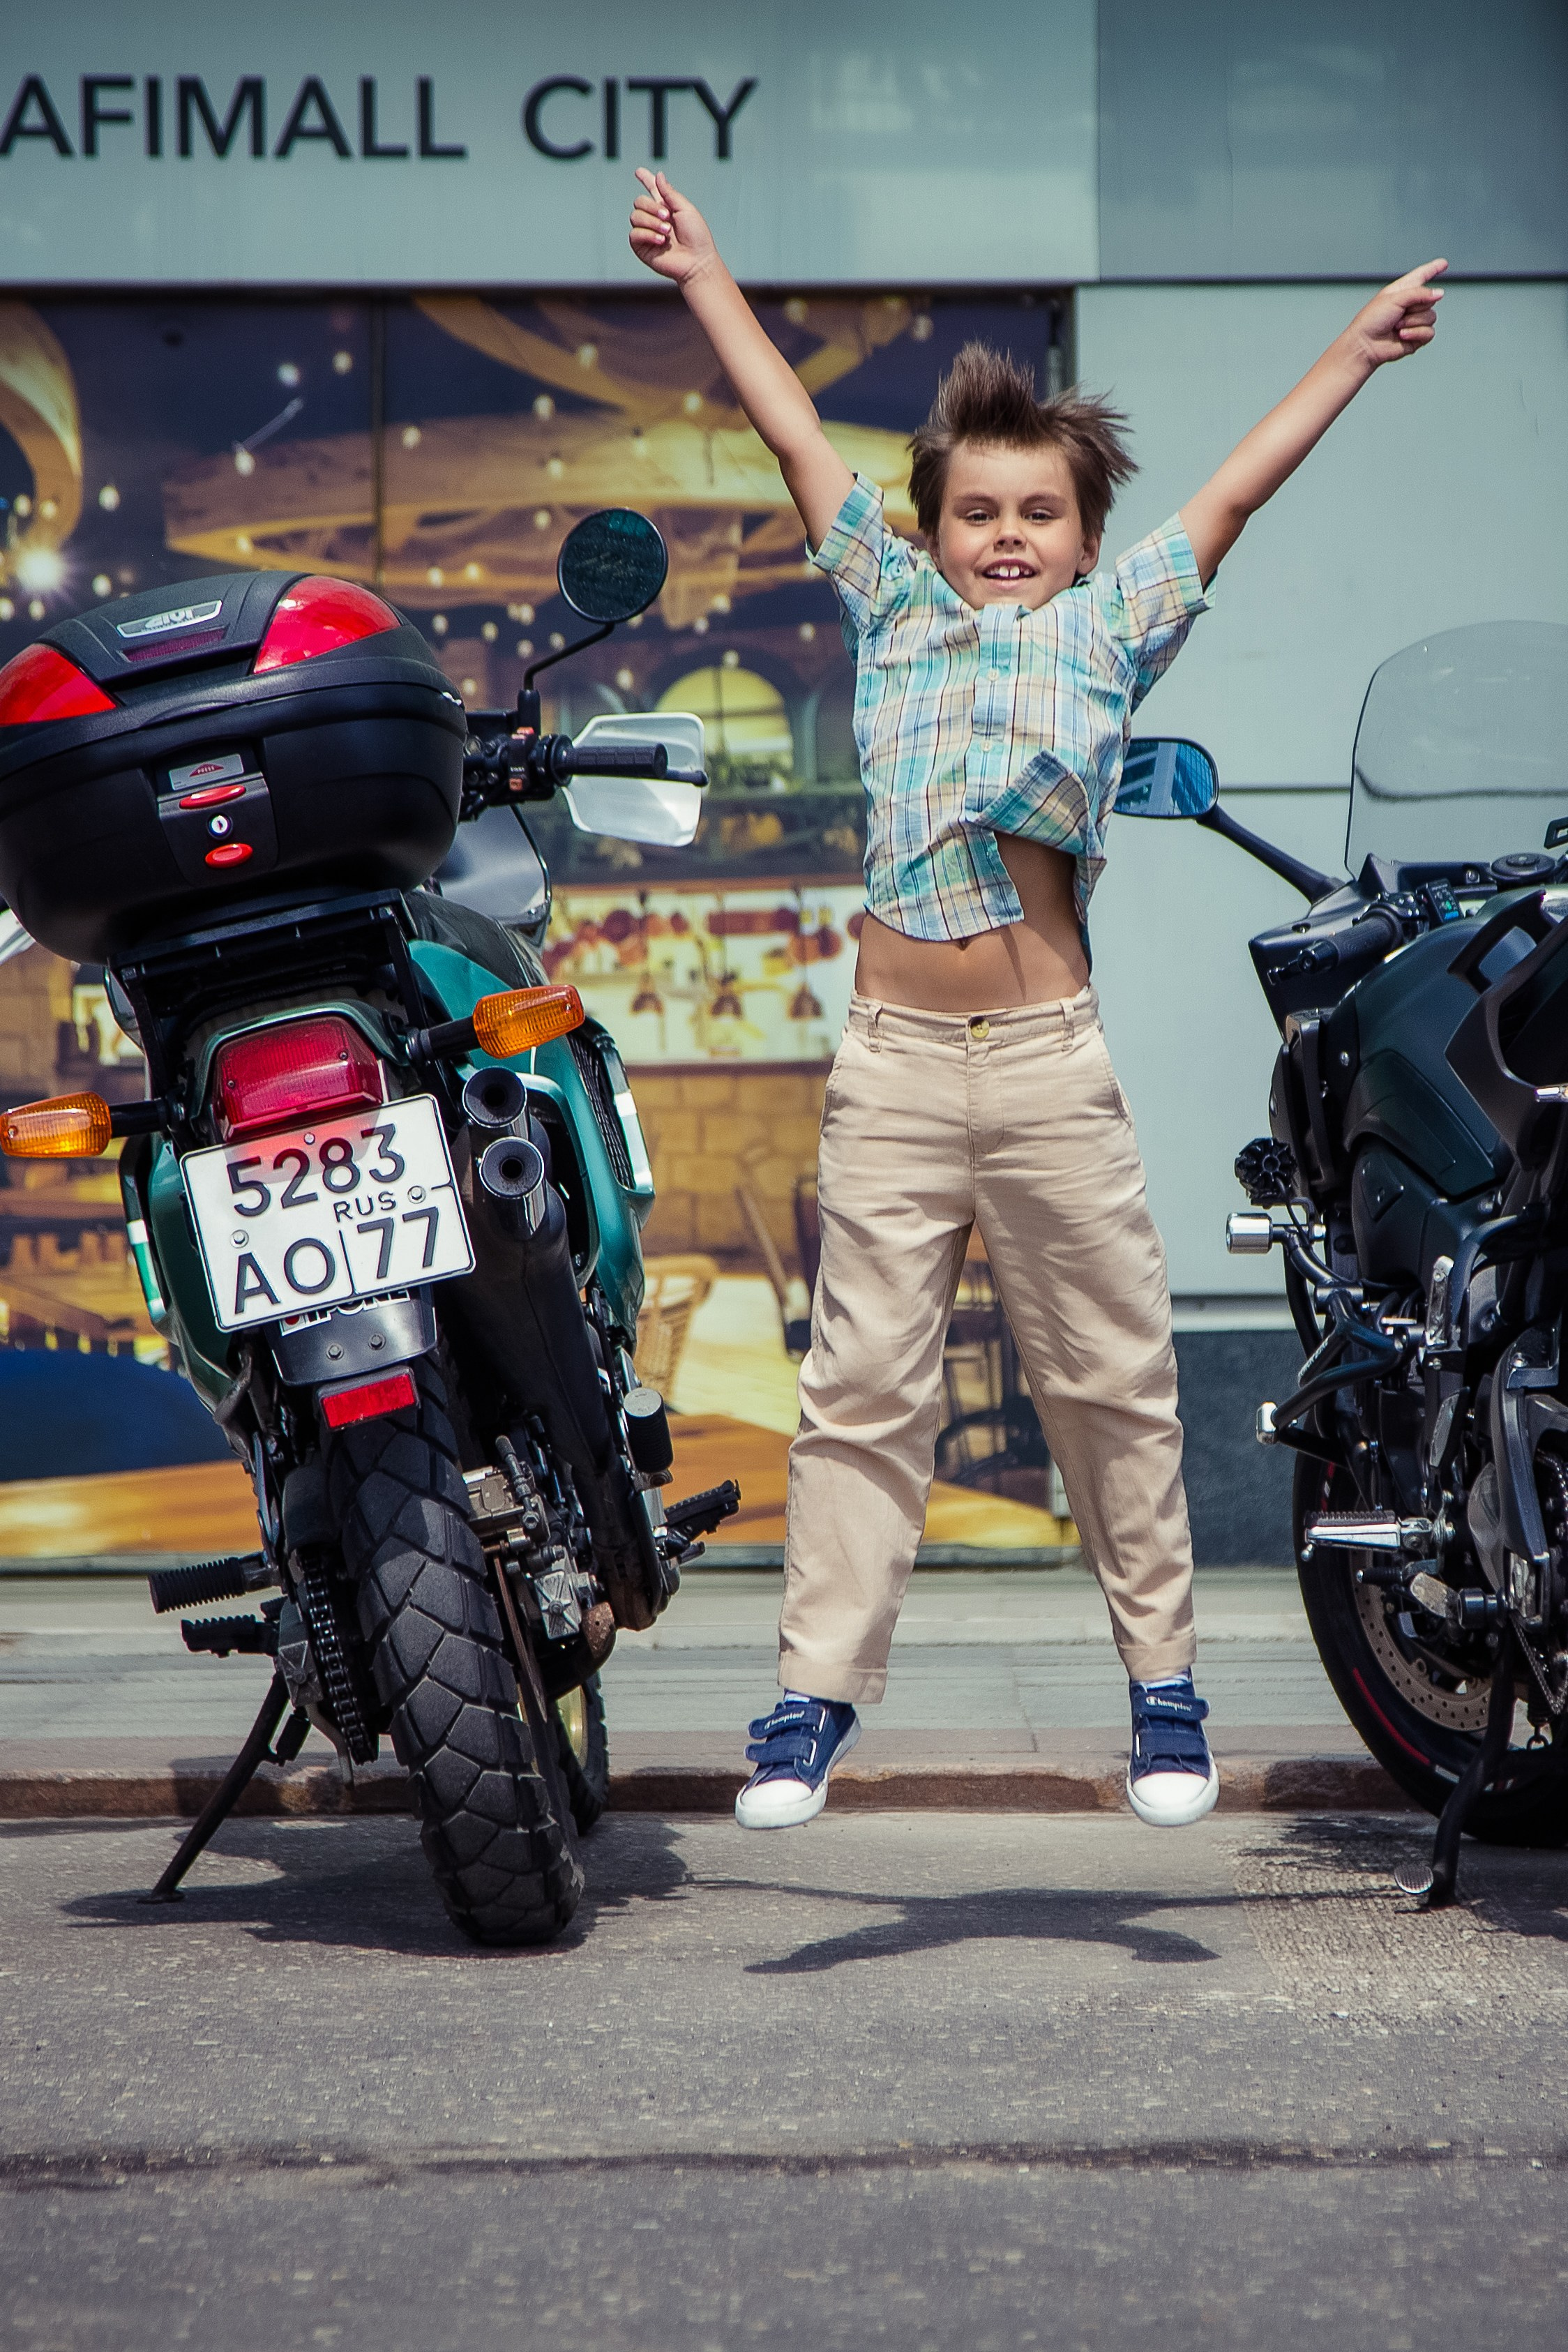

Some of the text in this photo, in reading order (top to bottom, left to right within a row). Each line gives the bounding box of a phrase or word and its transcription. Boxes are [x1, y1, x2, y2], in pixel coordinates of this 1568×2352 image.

[0, 71, 758, 161] AFIMALL CITY
[227, 1123, 405, 1217] 5283
[333, 1191, 396, 1223] RUS
[234, 1237, 336, 1315] AO
[356, 1206, 439, 1279] 77
